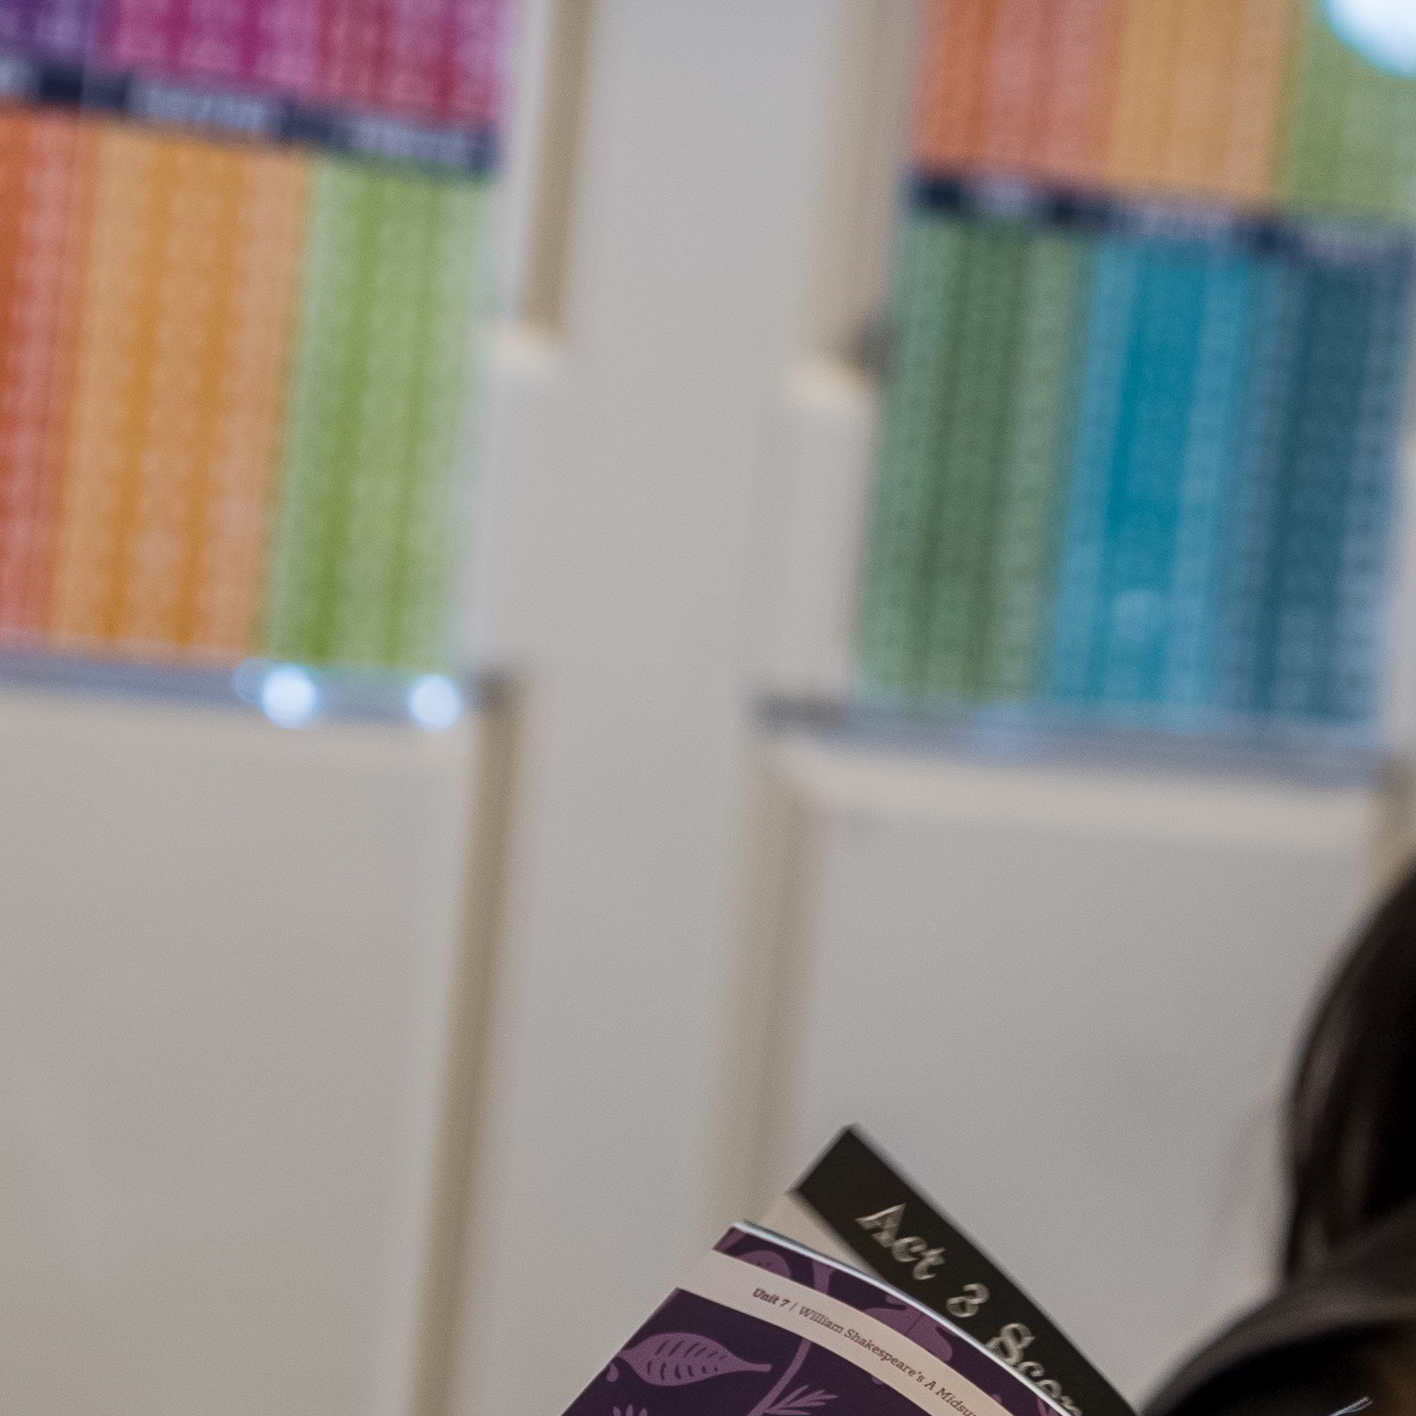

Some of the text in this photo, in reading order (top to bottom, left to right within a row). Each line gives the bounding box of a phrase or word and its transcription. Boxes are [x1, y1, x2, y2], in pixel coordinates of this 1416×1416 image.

[855, 1203, 946, 1280] Act
[946, 1282, 989, 1318] 3
[754, 1287, 779, 1305] Unit
[779, 1299, 791, 1307] 7
[798, 1306, 845, 1335] William
[843, 1328, 926, 1384] Shakespeare's
[924, 1381, 936, 1391] A
